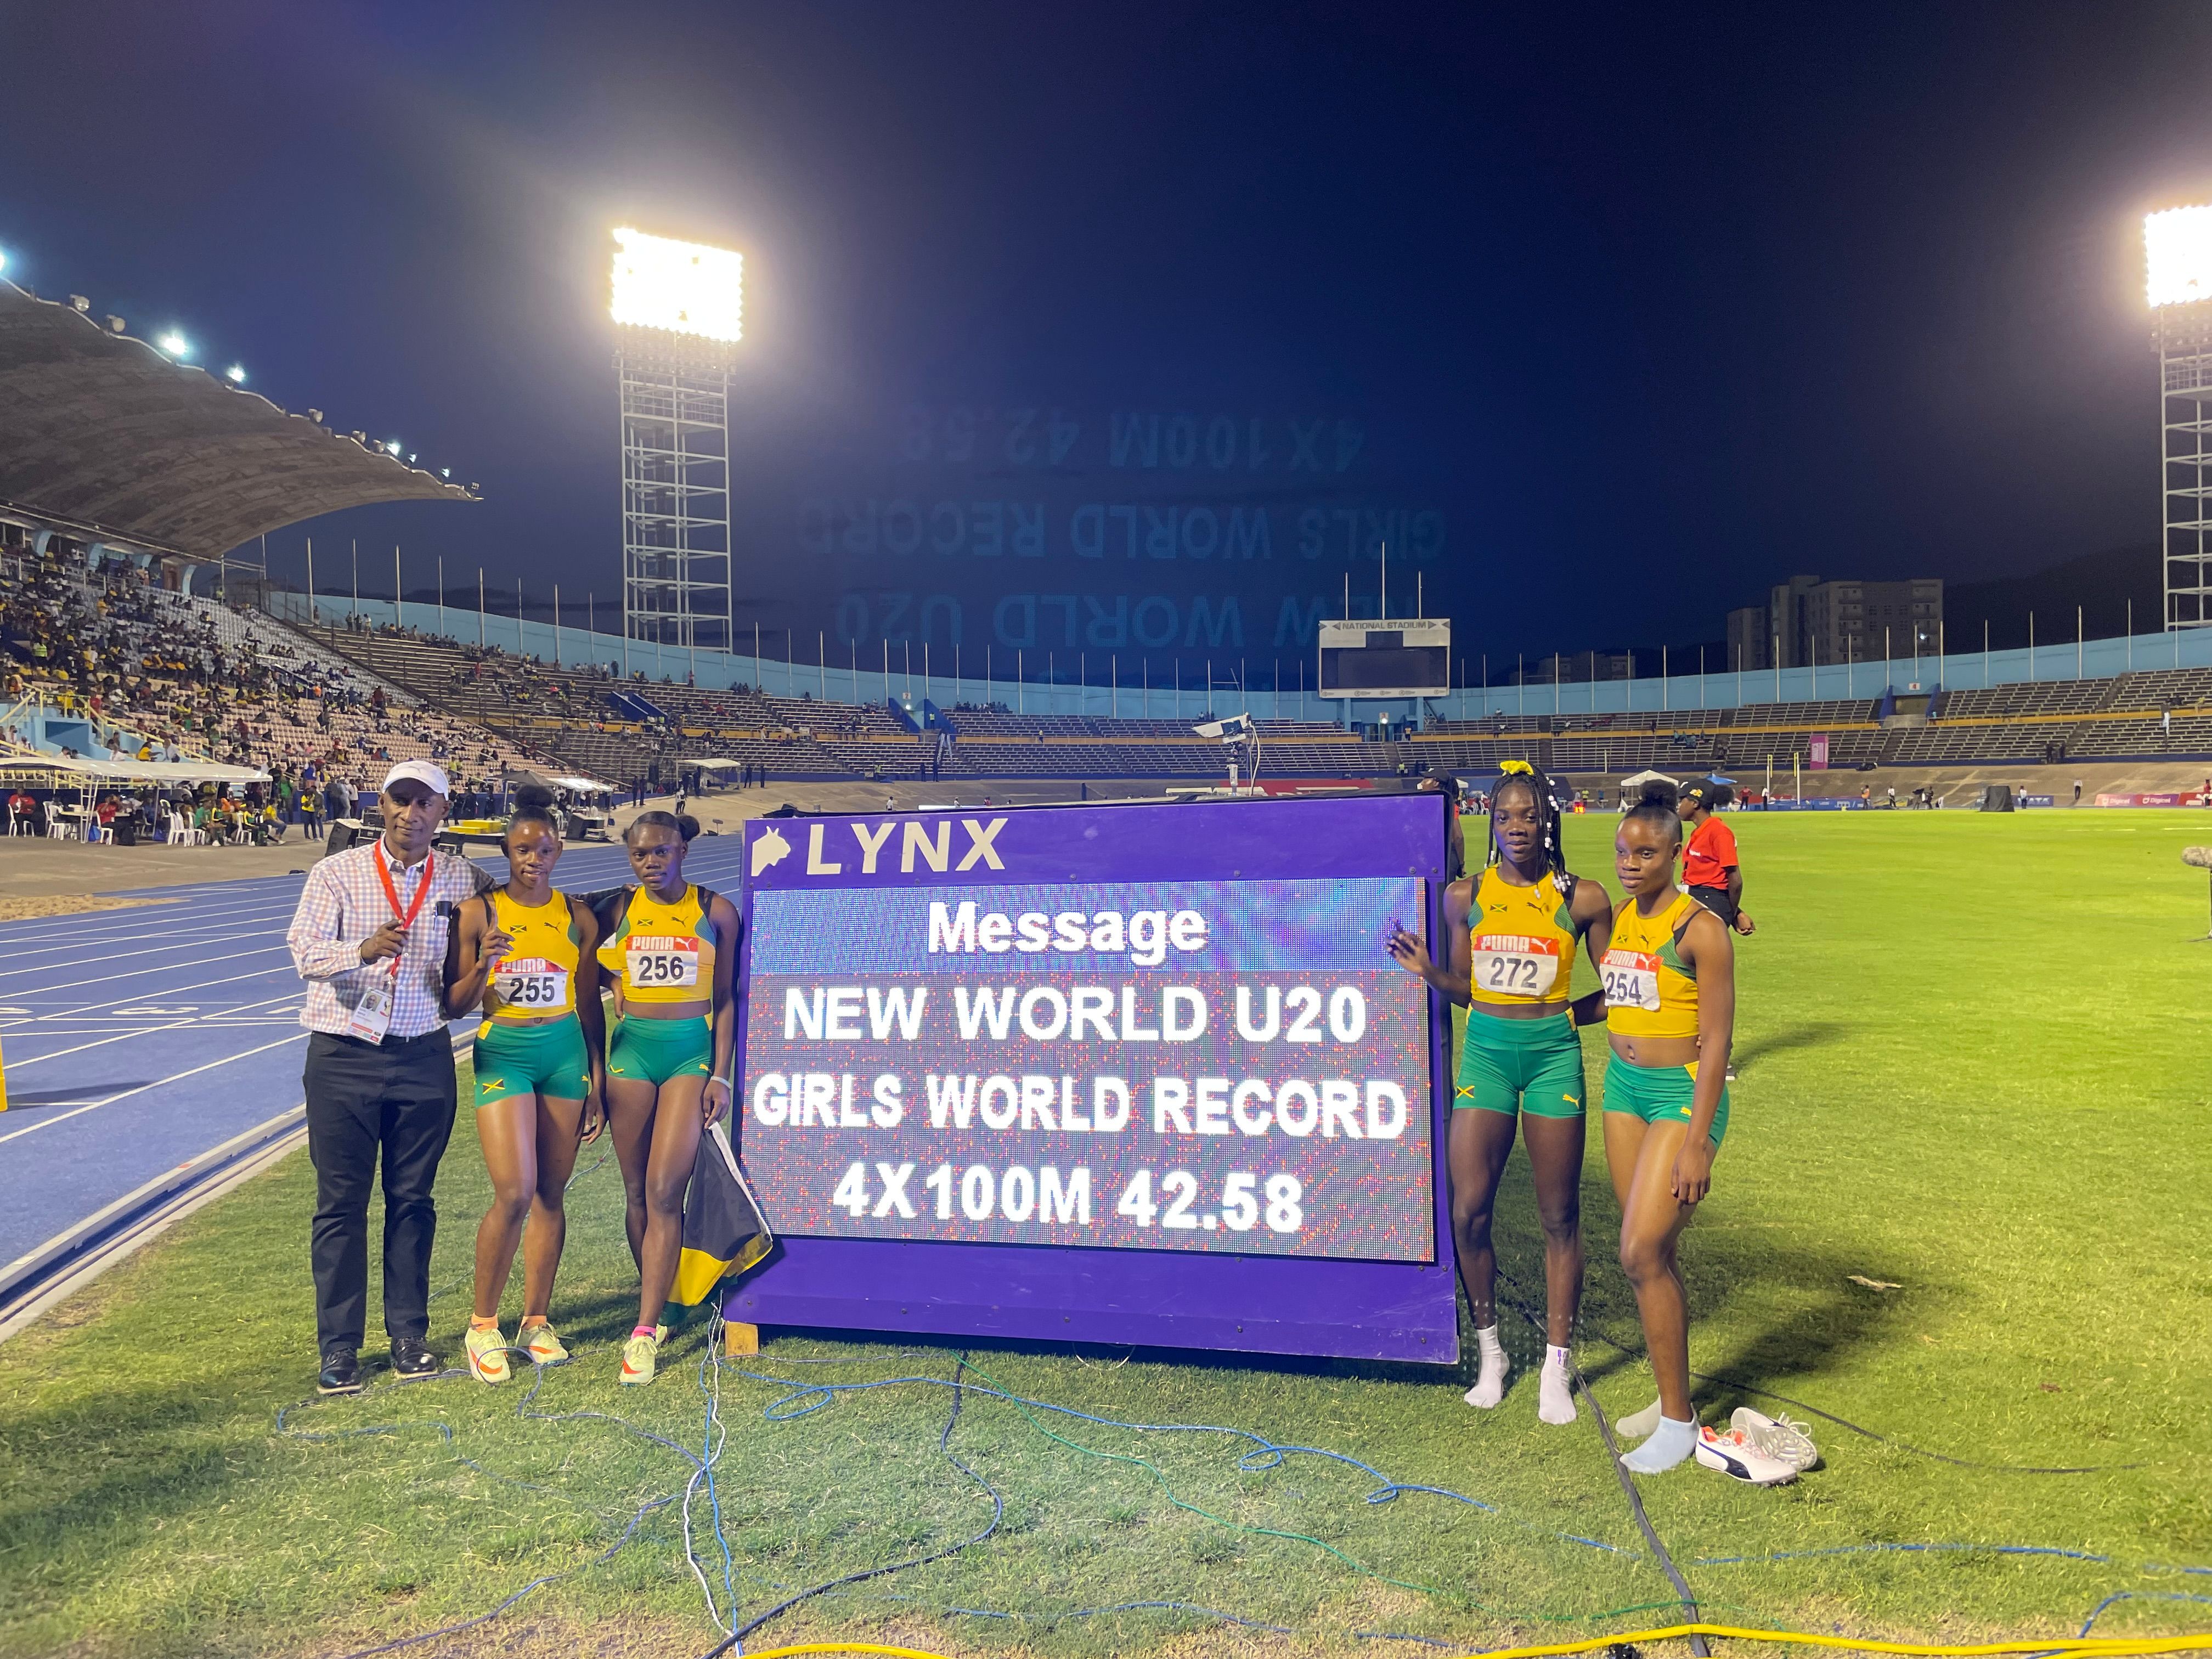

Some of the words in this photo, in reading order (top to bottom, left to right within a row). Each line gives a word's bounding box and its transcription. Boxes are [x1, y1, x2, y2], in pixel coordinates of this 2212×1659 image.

[1070, 504, 1272, 559] WORLD
[993, 594, 1243, 648] WORLD
[1387, 621, 1426, 629] STADIUM
[808, 818, 1007, 875] LYNX
[632, 936, 674, 950] PUMA
[928, 901, 1210, 966] Message
[1481, 934, 1530, 953] PUMA
[638, 956, 684, 981] 256
[1490, 957, 1538, 989] 272
[1604, 949, 1638, 967] PUMA
[509, 976, 556, 1002] 255
[1605, 971, 1642, 1005] 254
[784, 987, 927, 1041] NEW
[953, 986, 1207, 1042] WORLD
[1236, 986, 1367, 1043] U20
[753, 1073, 904, 1128] GIRLS
[926, 1074, 1131, 1133] WORLD
[1154, 1077, 1407, 1140] RECORD
[832, 1162, 1091, 1226] 4X100M
[1117, 1169, 1306, 1233] 42.58
